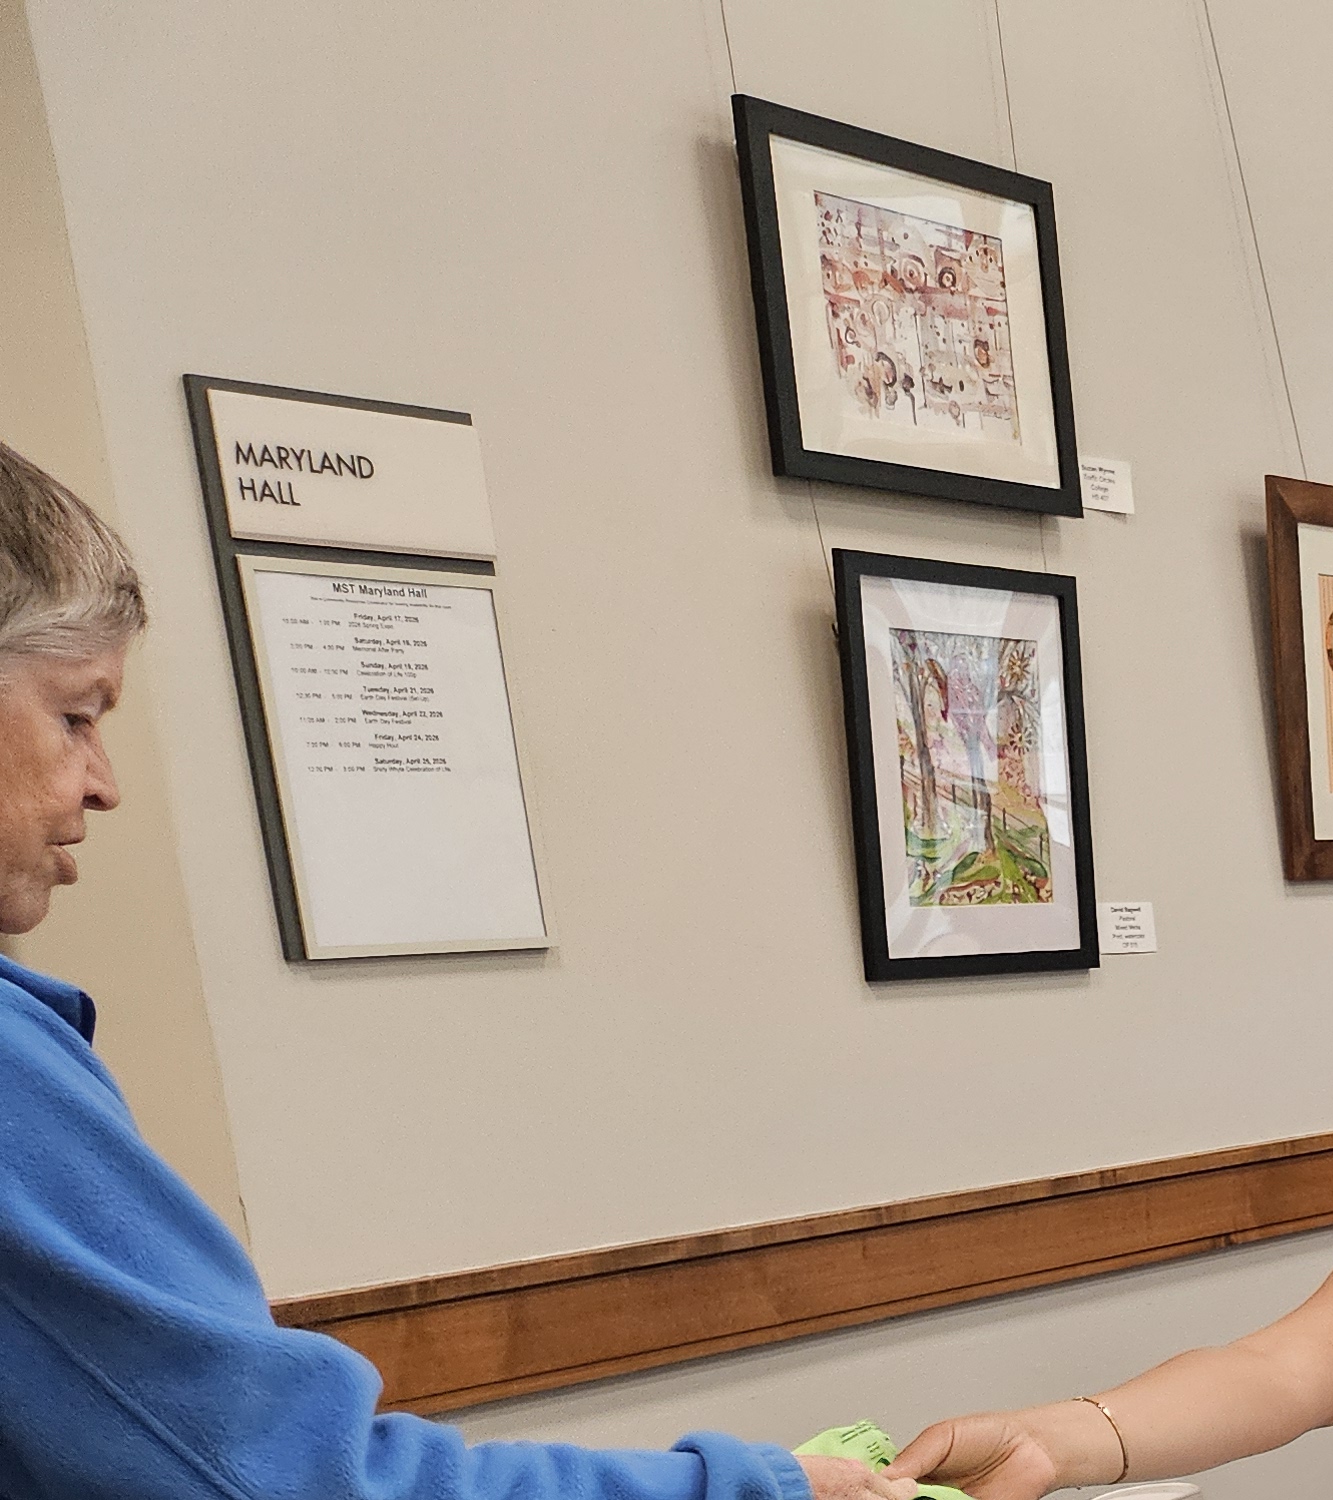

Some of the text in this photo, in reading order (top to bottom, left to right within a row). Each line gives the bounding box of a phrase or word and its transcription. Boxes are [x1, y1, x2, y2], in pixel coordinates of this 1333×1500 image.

[235, 441, 374, 479] MARYLAND
[238, 476, 301, 507] HALL
[332, 582, 428, 599] MST Maryland Hall
